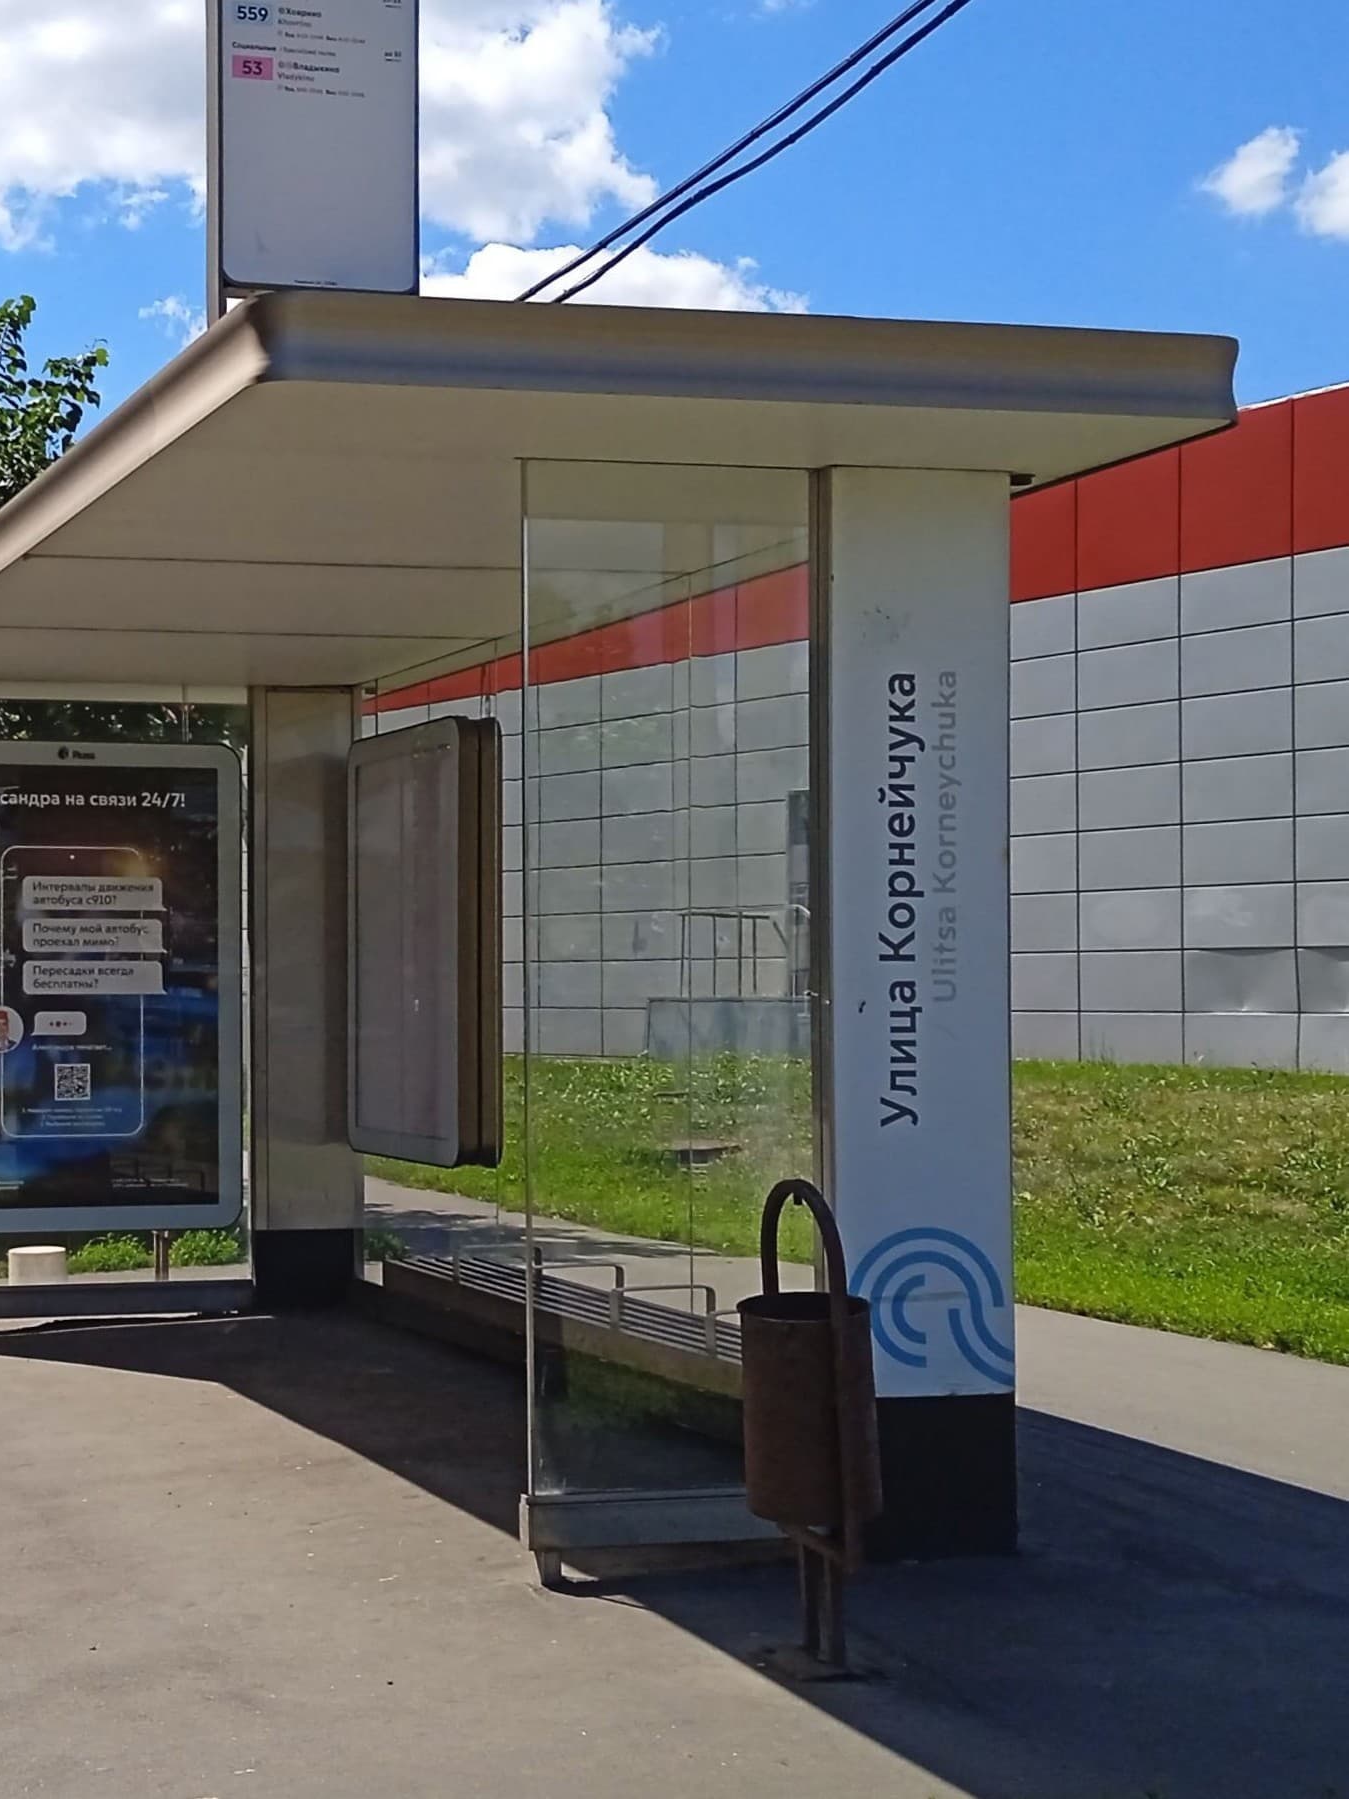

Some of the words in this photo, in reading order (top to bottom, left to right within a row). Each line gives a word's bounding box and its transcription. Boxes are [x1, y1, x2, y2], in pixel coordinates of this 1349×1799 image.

[236, 5, 269, 22] 559
[242, 60, 263, 76] 53
[931, 670, 963, 894] Korneychuka
[65, 794, 85, 806] на
[89, 794, 137, 807] связи
[141, 792, 186, 808] 24/7!
[877, 672, 926, 962] Корнейчука
[32, 881, 96, 893] Интервалы
[33, 895, 84, 906] автобуса
[33, 923, 76, 935] Почему
[78, 923, 104, 934] мой
[931, 905, 958, 1003] Ulitsa
[33, 965, 95, 977] Пересадки
[98, 967, 134, 977] всегда
[33, 979, 99, 990] бесплатны?
[879, 980, 923, 1128] Улица
